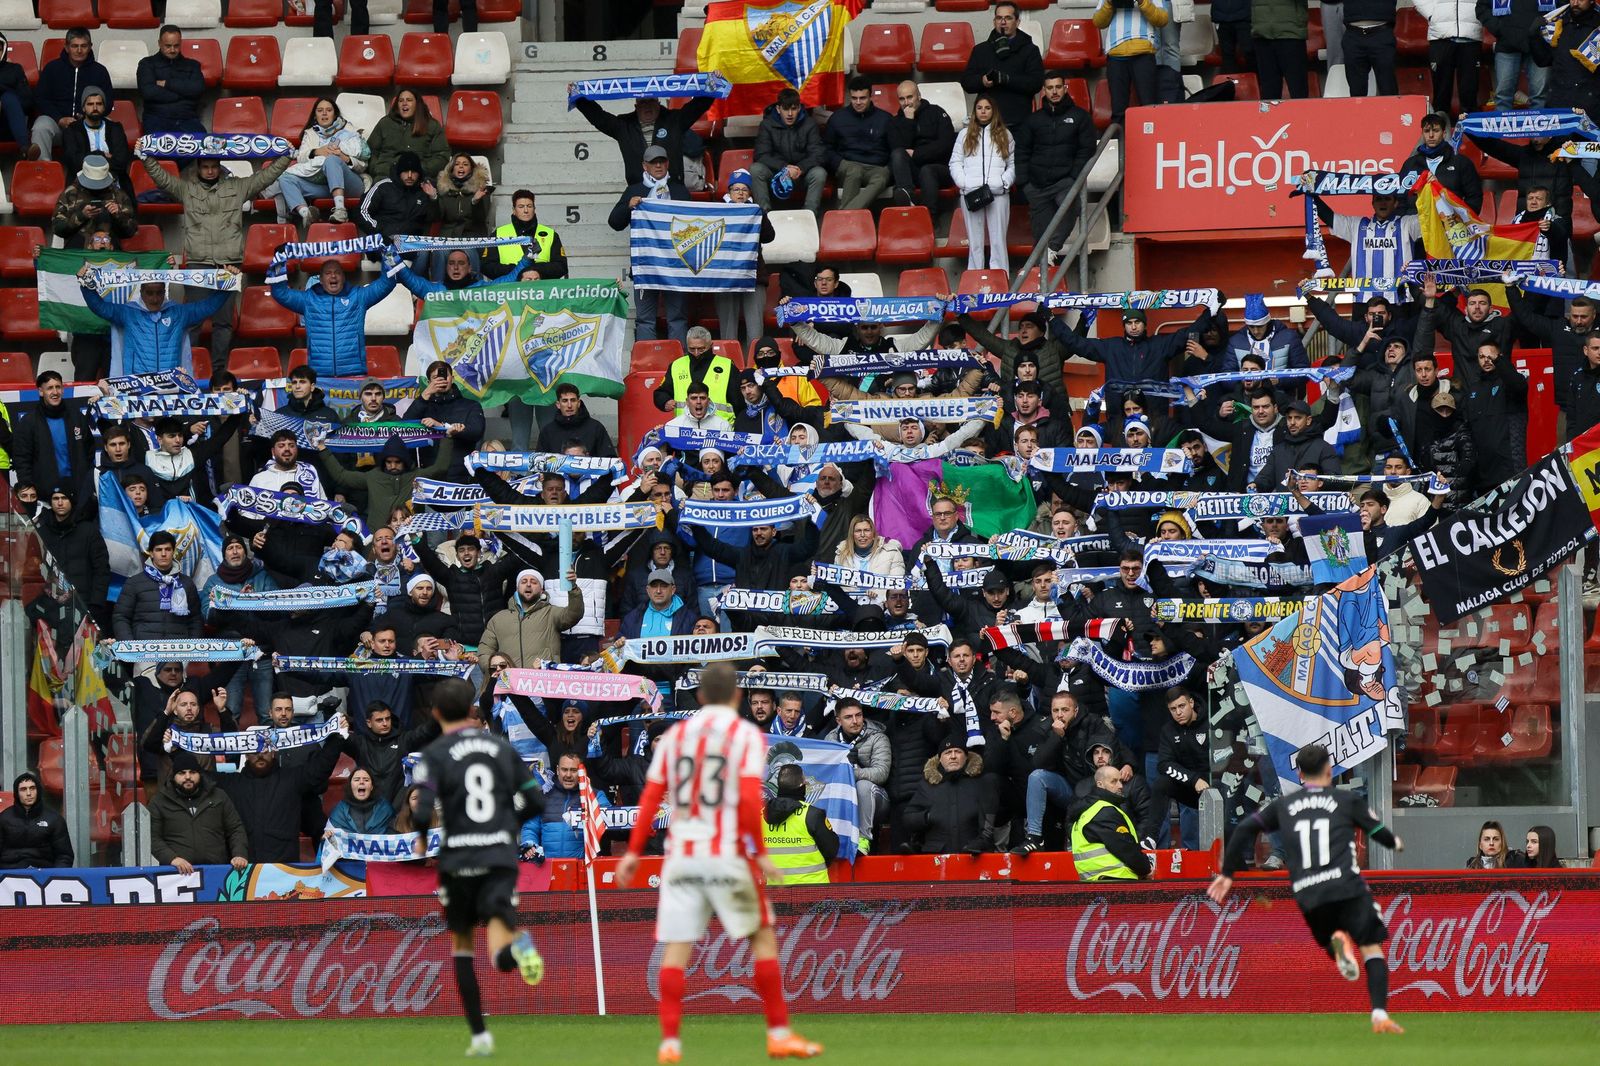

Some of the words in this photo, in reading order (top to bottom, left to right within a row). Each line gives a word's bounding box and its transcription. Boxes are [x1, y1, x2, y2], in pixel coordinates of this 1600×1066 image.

[660, 41, 672, 55] H
[766, 21, 804, 57] MALAGA
[525, 45, 538, 58] G
[592, 45, 608, 61] 8
[583, 74, 701, 96] MALAGA
[1481, 114, 1561, 133] MALAGA
[231, 133, 290, 153] 300
[574, 142, 590, 161] 6
[1155, 124, 1311, 190] Halcón
[1321, 173, 1400, 192] MALAGA
[566, 205, 581, 224] 5
[681, 229, 708, 249] MALAGA
[1363, 237, 1395, 249] MALAGA
[1425, 259, 1514, 272] MALAGA
[459, 287, 545, 305] Malaguista
[549, 284, 619, 300] Archidon
[1163, 289, 1215, 306] SUR
[809, 303, 856, 316] PORTO
[871, 302, 924, 316] MALAGA
[906, 350, 969, 362] MALAGA
[127, 397, 220, 413] MALAGA
[863, 405, 964, 419] INVENCIBLES
[680, 429, 729, 440] MALAGA
[744, 445, 786, 458] ORZA
[1066, 452, 1131, 467] MALAGA
[433, 486, 447, 499] A.
[514, 511, 621, 526] INVENCIBLES
[684, 506, 731, 520] PORQUE
[735, 509, 747, 520] TE
[750, 504, 795, 519] QUIERO
[926, 542, 990, 559] ONDO
[1414, 531, 1450, 571] EL
[817, 565, 836, 582] DE
[839, 567, 906, 590] PADRES
[1503, 573, 1529, 592] CLUB
[1532, 563, 1544, 578] DE
[725, 590, 783, 610] ONDO
[1178, 602, 1230, 619] FRENTE
[782, 627, 843, 642] FRENTE
[117, 640, 240, 652] ARCHIDONA
[642, 640, 668, 660] ¡LO
[672, 635, 748, 656] HICIMOS!
[279, 658, 346, 669] FRENTE
[516, 678, 631, 698] MALAGUISTA
[171, 729, 190, 749] DE
[192, 732, 259, 752] PADRES
[297, 714, 339, 743] HIJOS
[675, 755, 727, 807] 23
[464, 762, 496, 824] 8
[569, 809, 641, 828] FNDO
[1293, 818, 1331, 870] 11
[1066, 894, 1252, 1000] Coca-Cola
